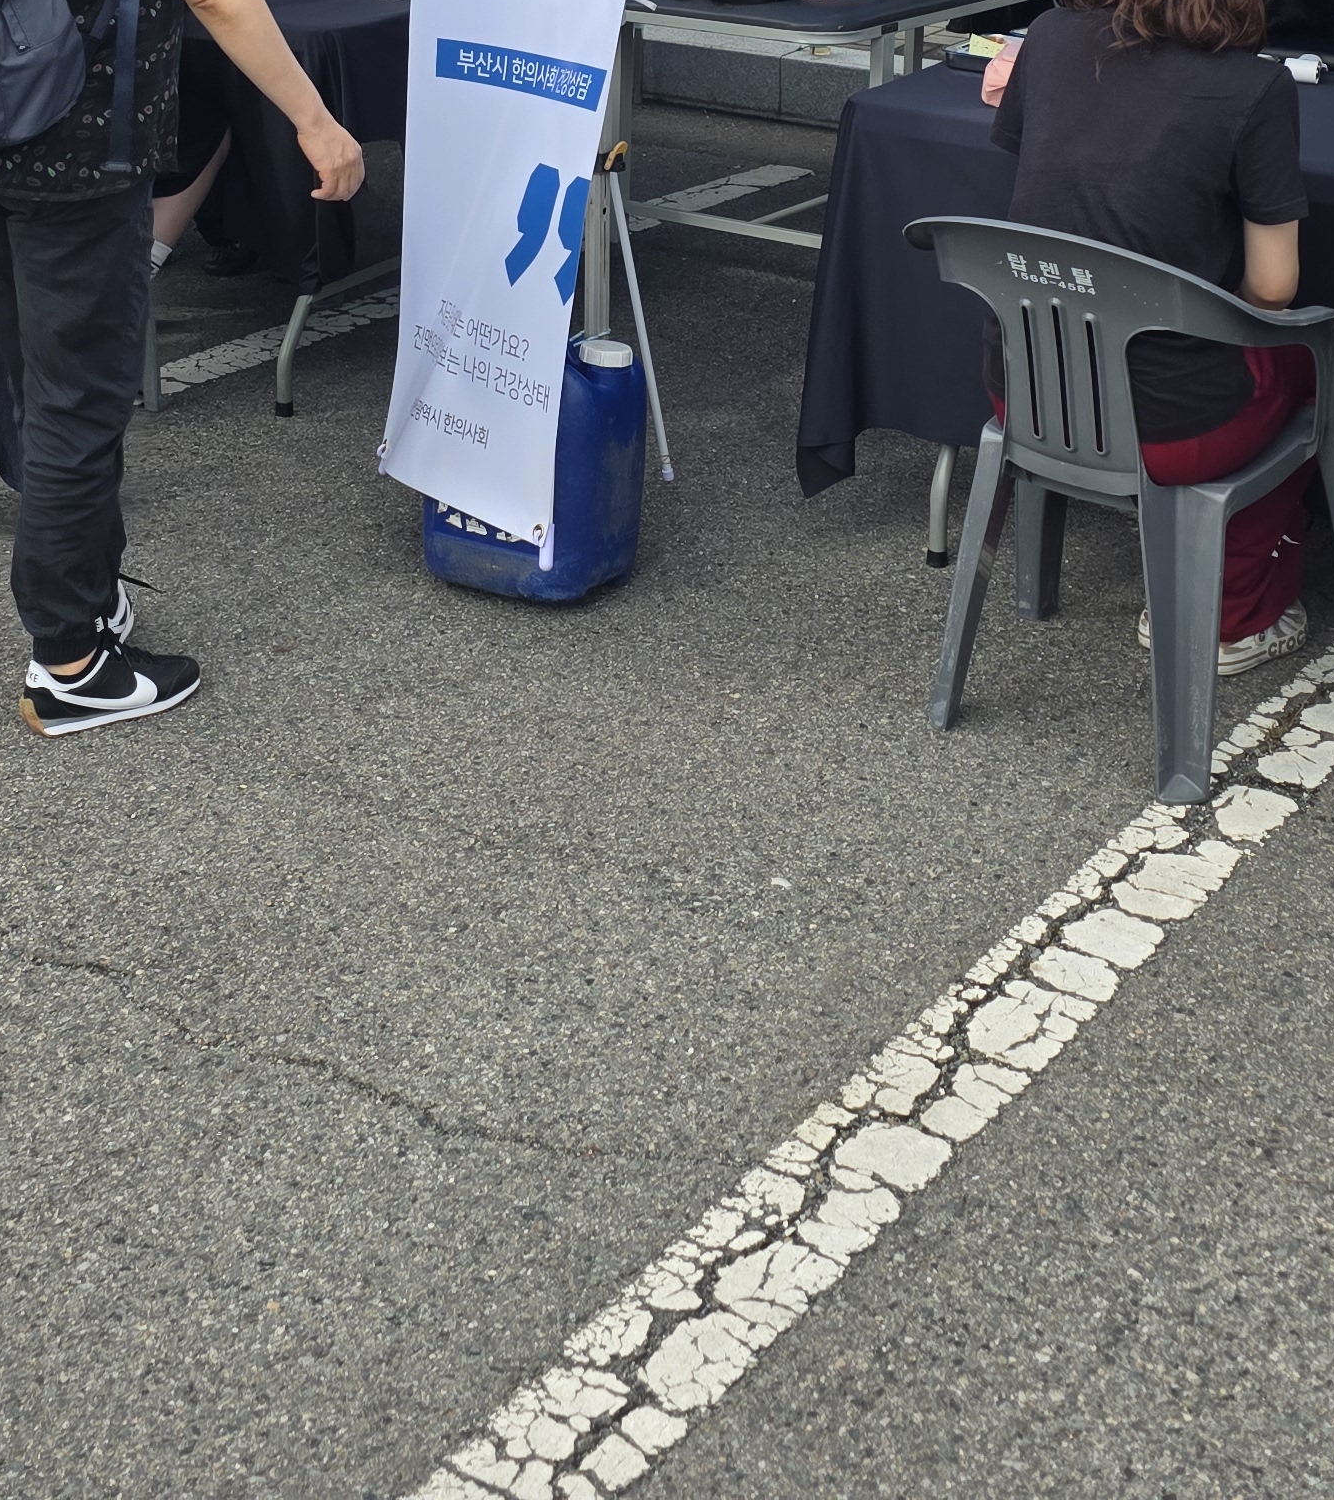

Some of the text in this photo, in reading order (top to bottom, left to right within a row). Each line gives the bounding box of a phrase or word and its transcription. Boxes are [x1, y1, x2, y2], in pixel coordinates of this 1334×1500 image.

[456, 49, 508, 81] 부산시
[512, 57, 559, 92] 한의사회
[1012, 270, 1096, 295] 1566-4584
[466, 318, 530, 362] 어떤가요?
[463, 354, 491, 388] 나의
[493, 365, 551, 414] 건강상태
[443, 412, 490, 450] 한의사회
